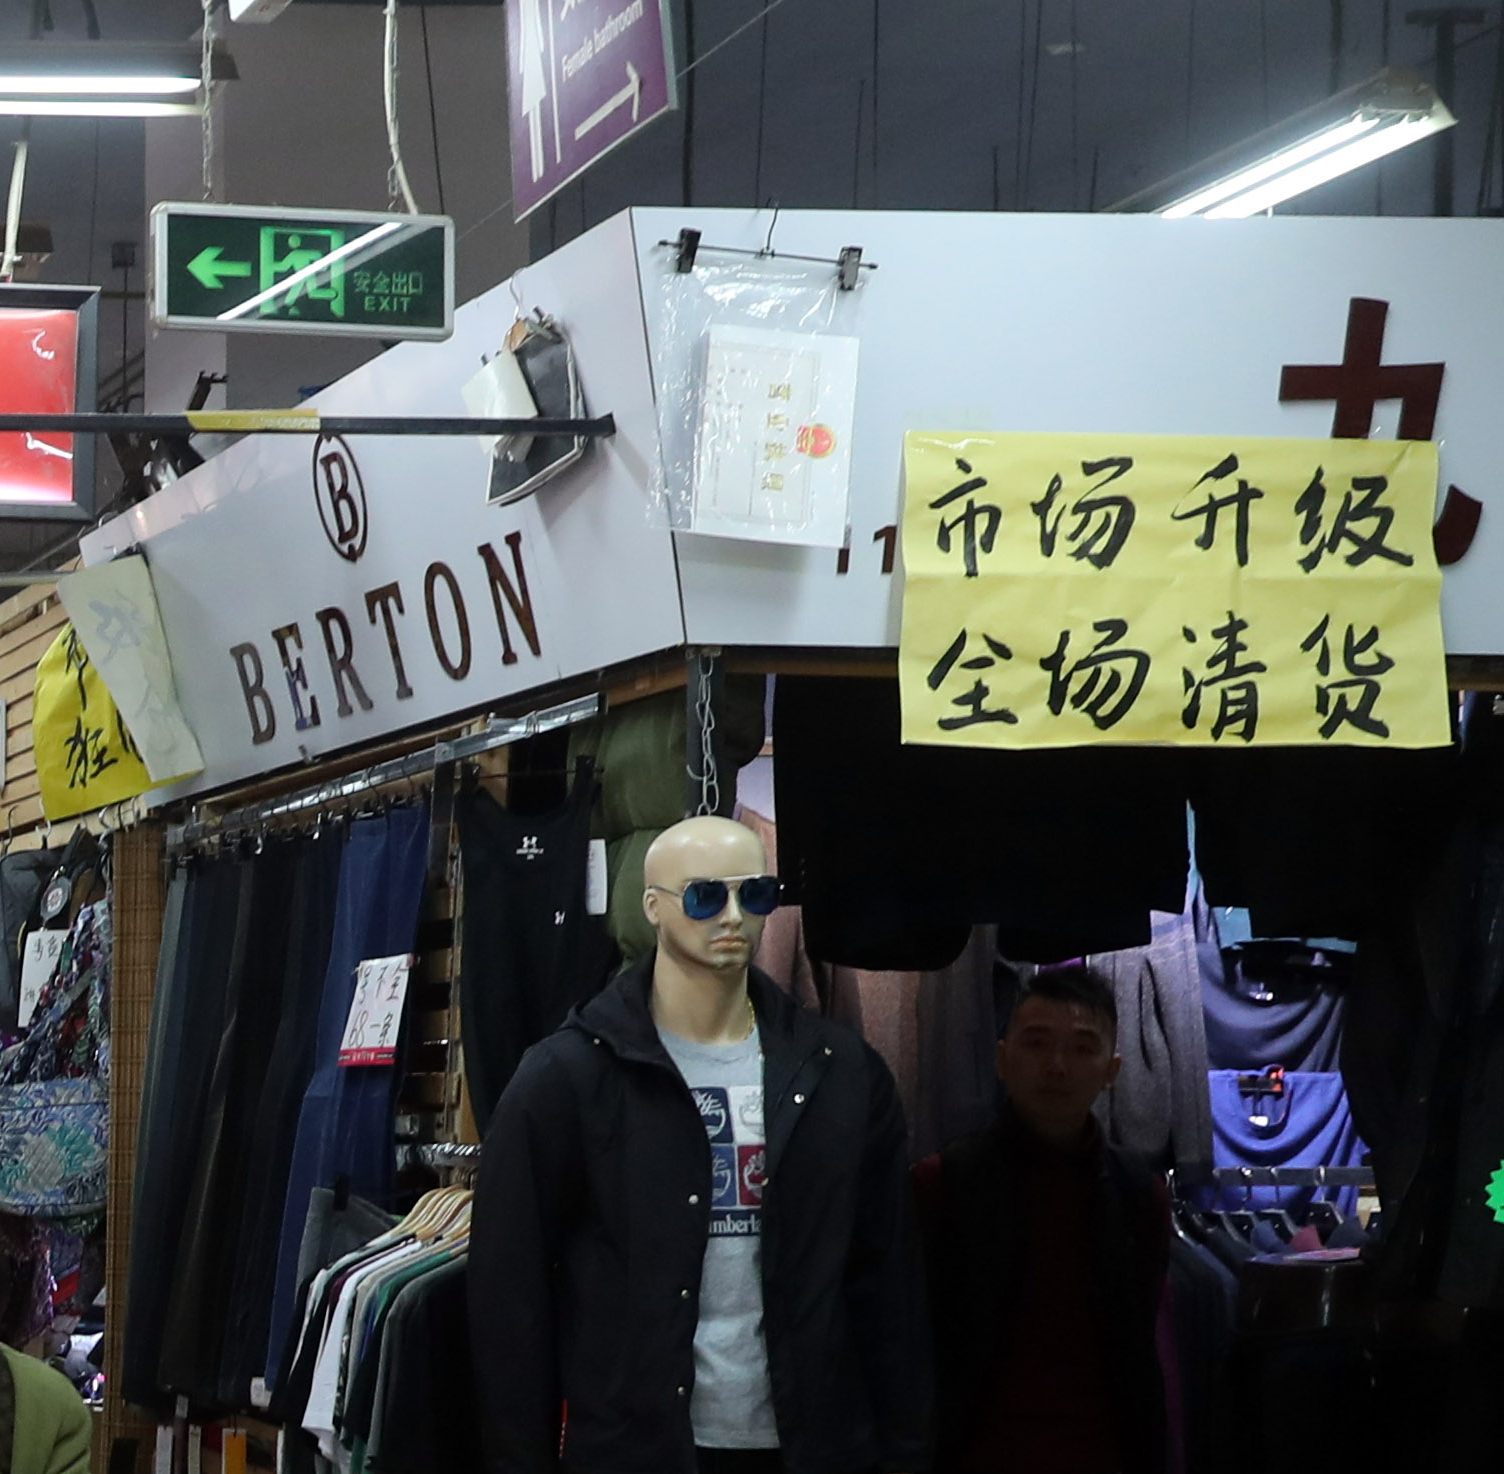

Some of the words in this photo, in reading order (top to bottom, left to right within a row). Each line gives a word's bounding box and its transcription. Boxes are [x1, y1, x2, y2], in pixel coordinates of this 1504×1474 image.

[353, 271, 423, 295] 安全出口
[364, 295, 412, 313] EXIT
[926, 455, 1416, 579] 市场升级
[229, 530, 544, 746] BERTON
[925, 611, 1396, 742] 全场清货
